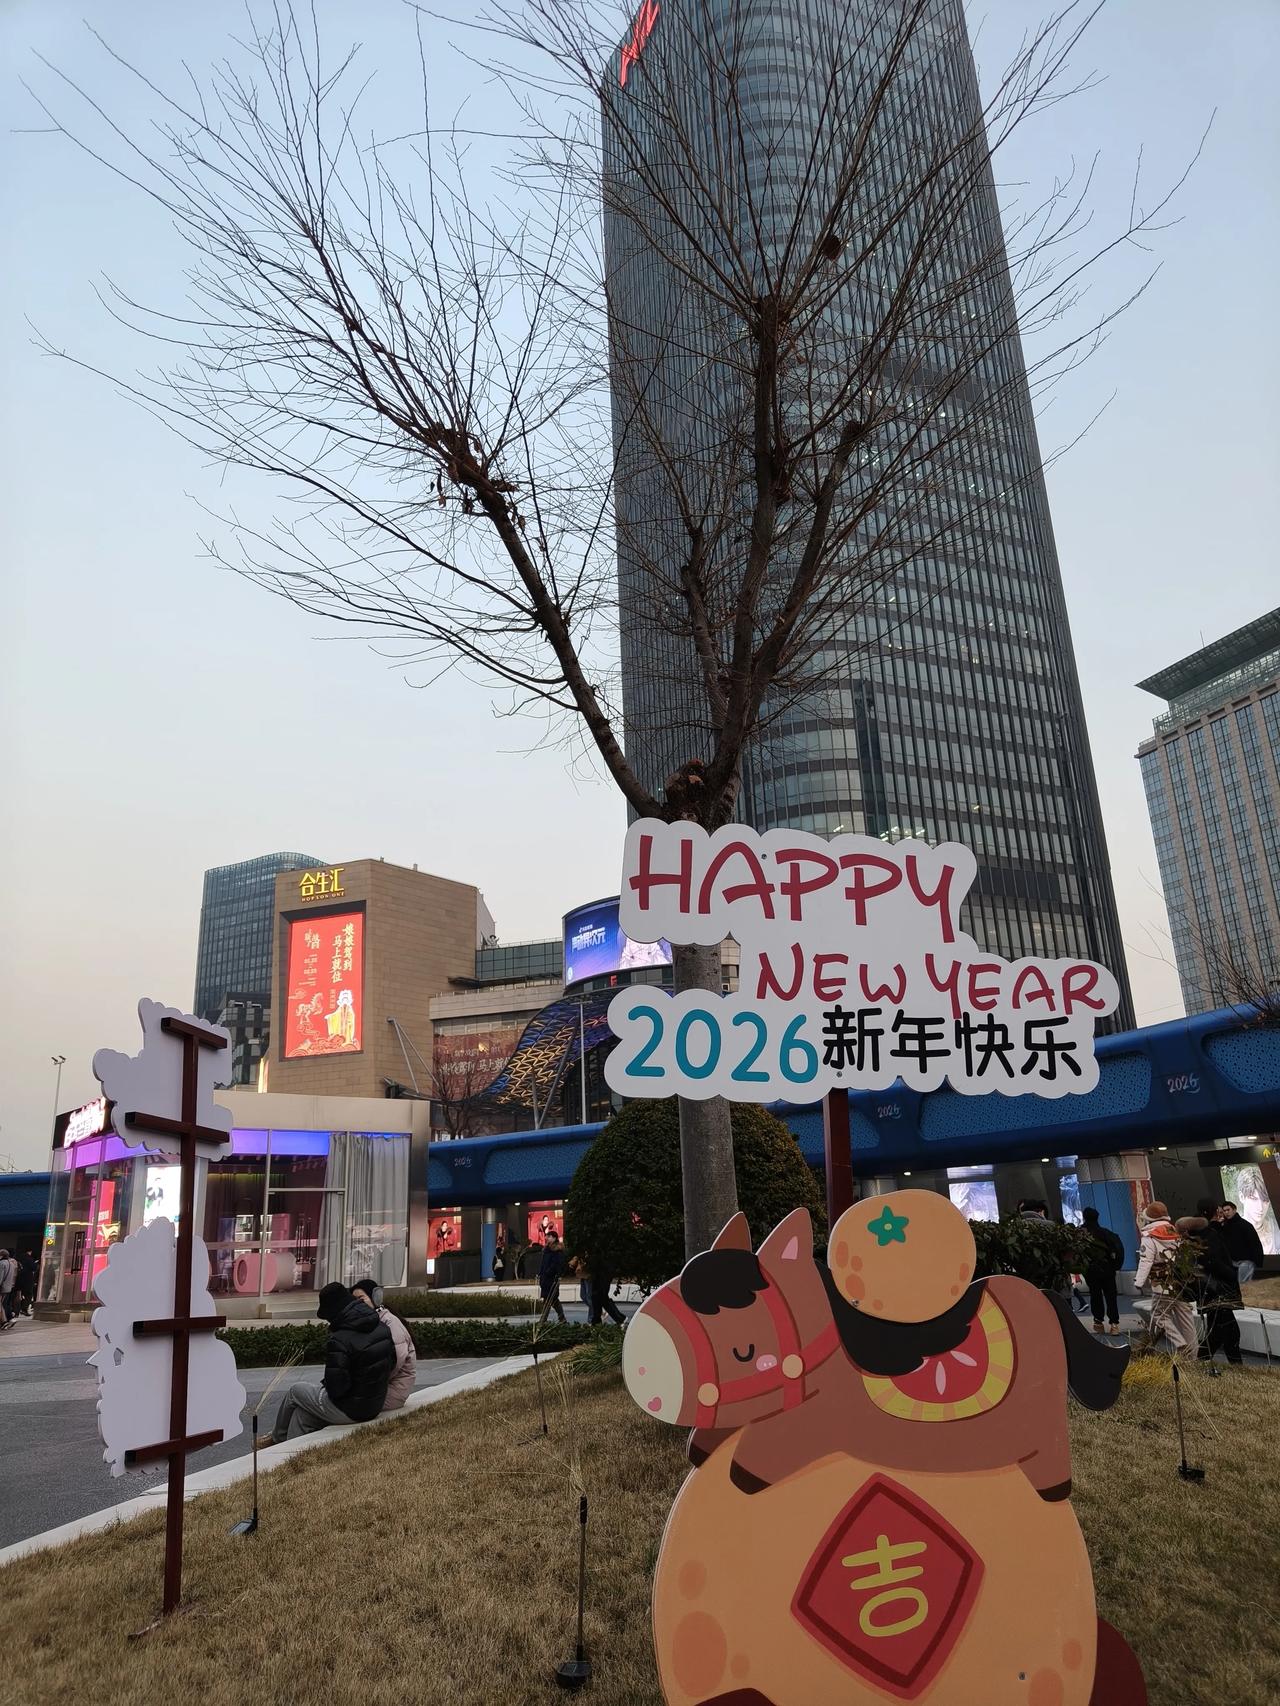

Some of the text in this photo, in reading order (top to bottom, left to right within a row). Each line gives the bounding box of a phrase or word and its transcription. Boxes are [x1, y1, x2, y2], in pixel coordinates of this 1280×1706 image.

[299, 868, 345, 897] 合生汇
[629, 834, 955, 944] HAPPY
[756, 943, 1106, 1020] NEW YEAR
[624, 1004, 1083, 1084] 2026新年快乐
[877, 1104, 902, 1119] 2026
[1167, 1072, 1201, 1094] 2026
[841, 1534, 929, 1638] 吉
